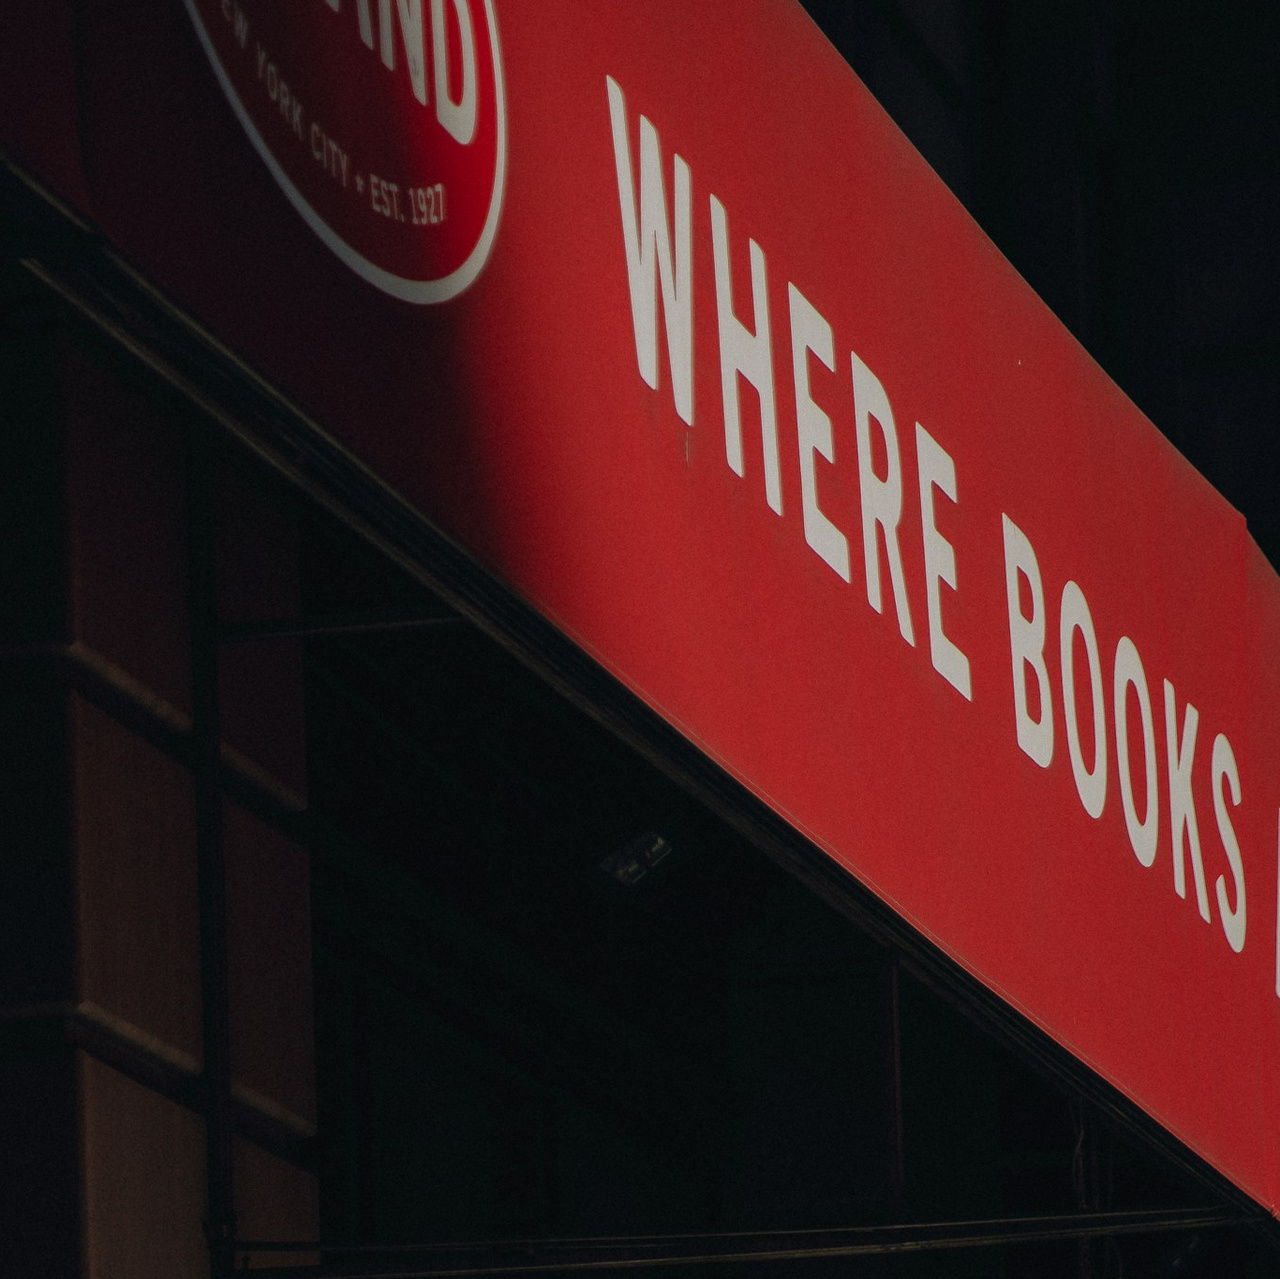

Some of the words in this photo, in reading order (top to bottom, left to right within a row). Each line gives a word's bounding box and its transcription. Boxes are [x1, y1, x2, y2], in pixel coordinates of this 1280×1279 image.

[257, 41, 303, 140] YORK
[310, 122, 350, 189] CITY
[370, 174, 405, 223] EST.
[412, 182, 445, 225] 1927
[607, 74, 972, 701] WHERE
[1003, 512, 1247, 953] BOOKS
